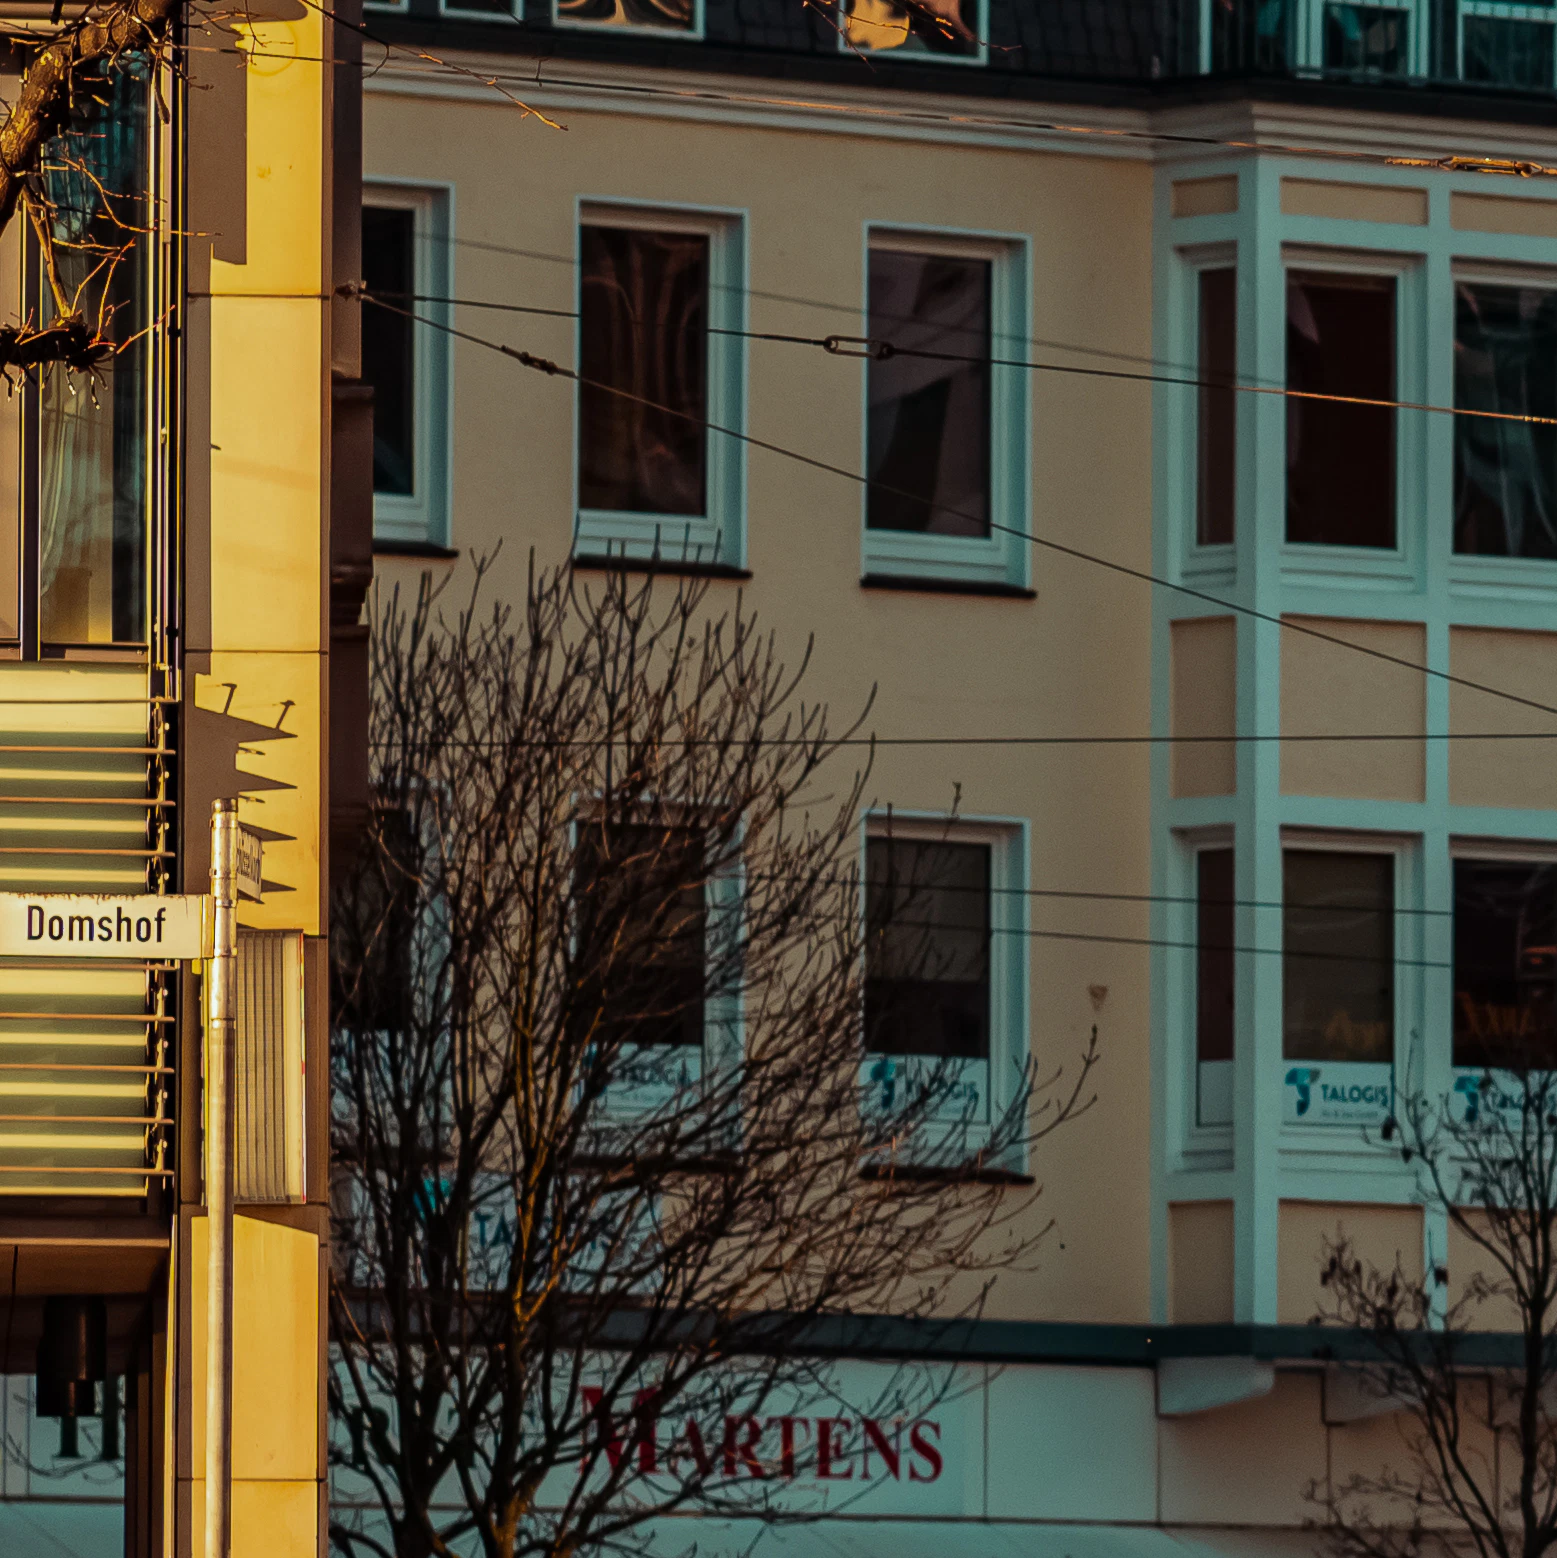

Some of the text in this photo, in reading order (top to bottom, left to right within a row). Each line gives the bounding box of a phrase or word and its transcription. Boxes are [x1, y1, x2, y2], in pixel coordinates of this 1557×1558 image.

[27, 904, 167, 943] Domshof
[1321, 1083, 1389, 1107] TALOGIS
[577, 1385, 944, 1483] MARTENS
